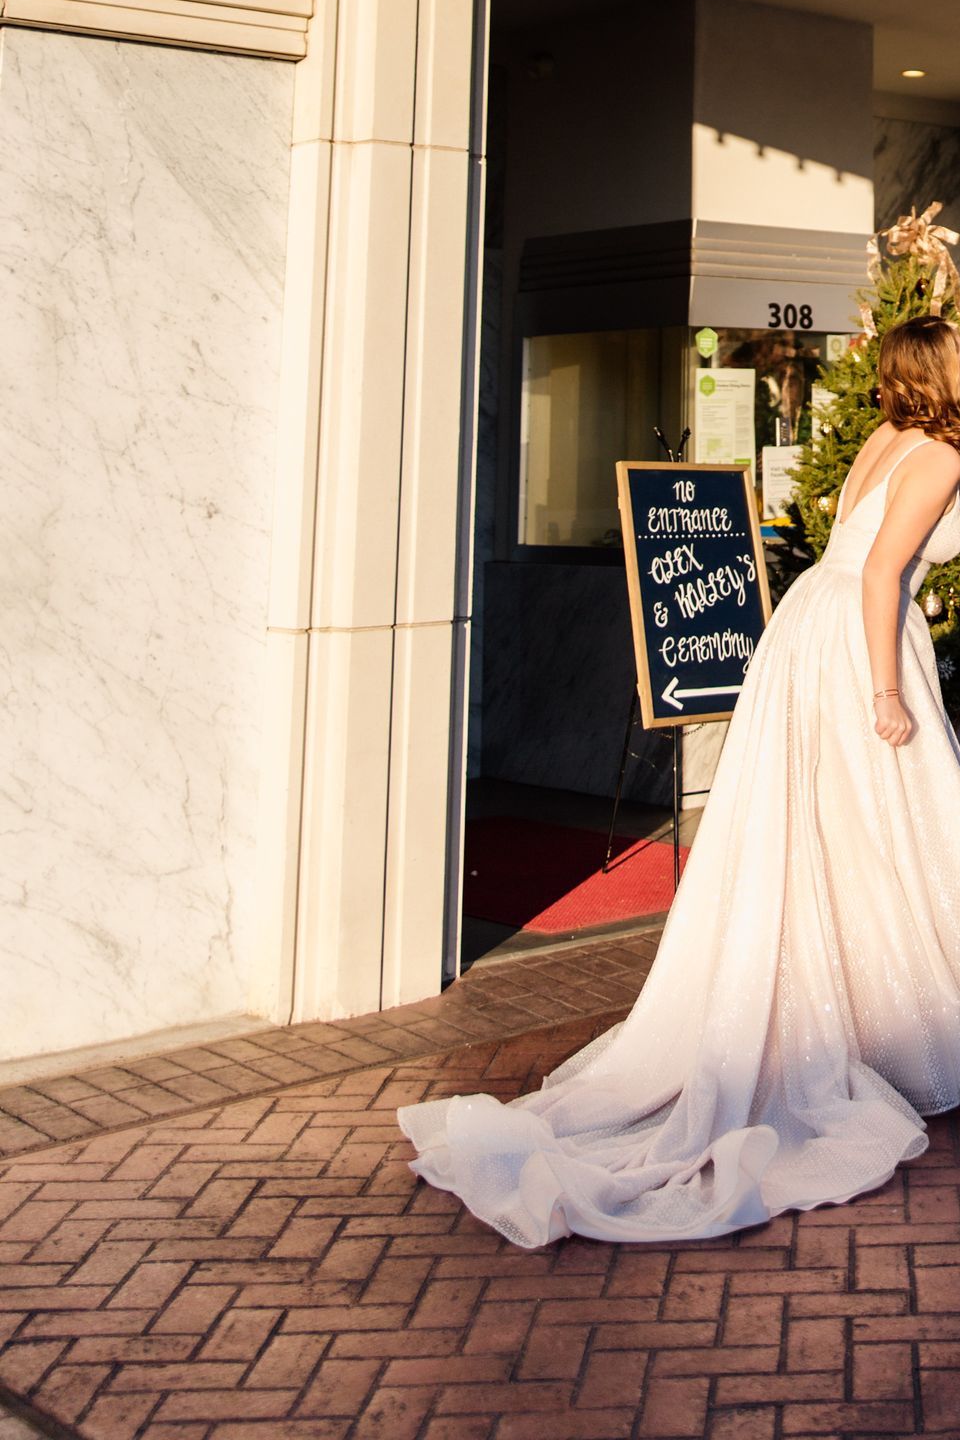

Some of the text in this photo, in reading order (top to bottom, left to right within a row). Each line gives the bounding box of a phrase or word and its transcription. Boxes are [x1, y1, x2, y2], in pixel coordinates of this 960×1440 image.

[767, 302, 813, 329] 308
[672, 480, 696, 503] NO
[647, 506, 732, 534] ENTRANCE
[647, 542, 704, 584] ALEX
[659, 628, 754, 674] CEREMONY
